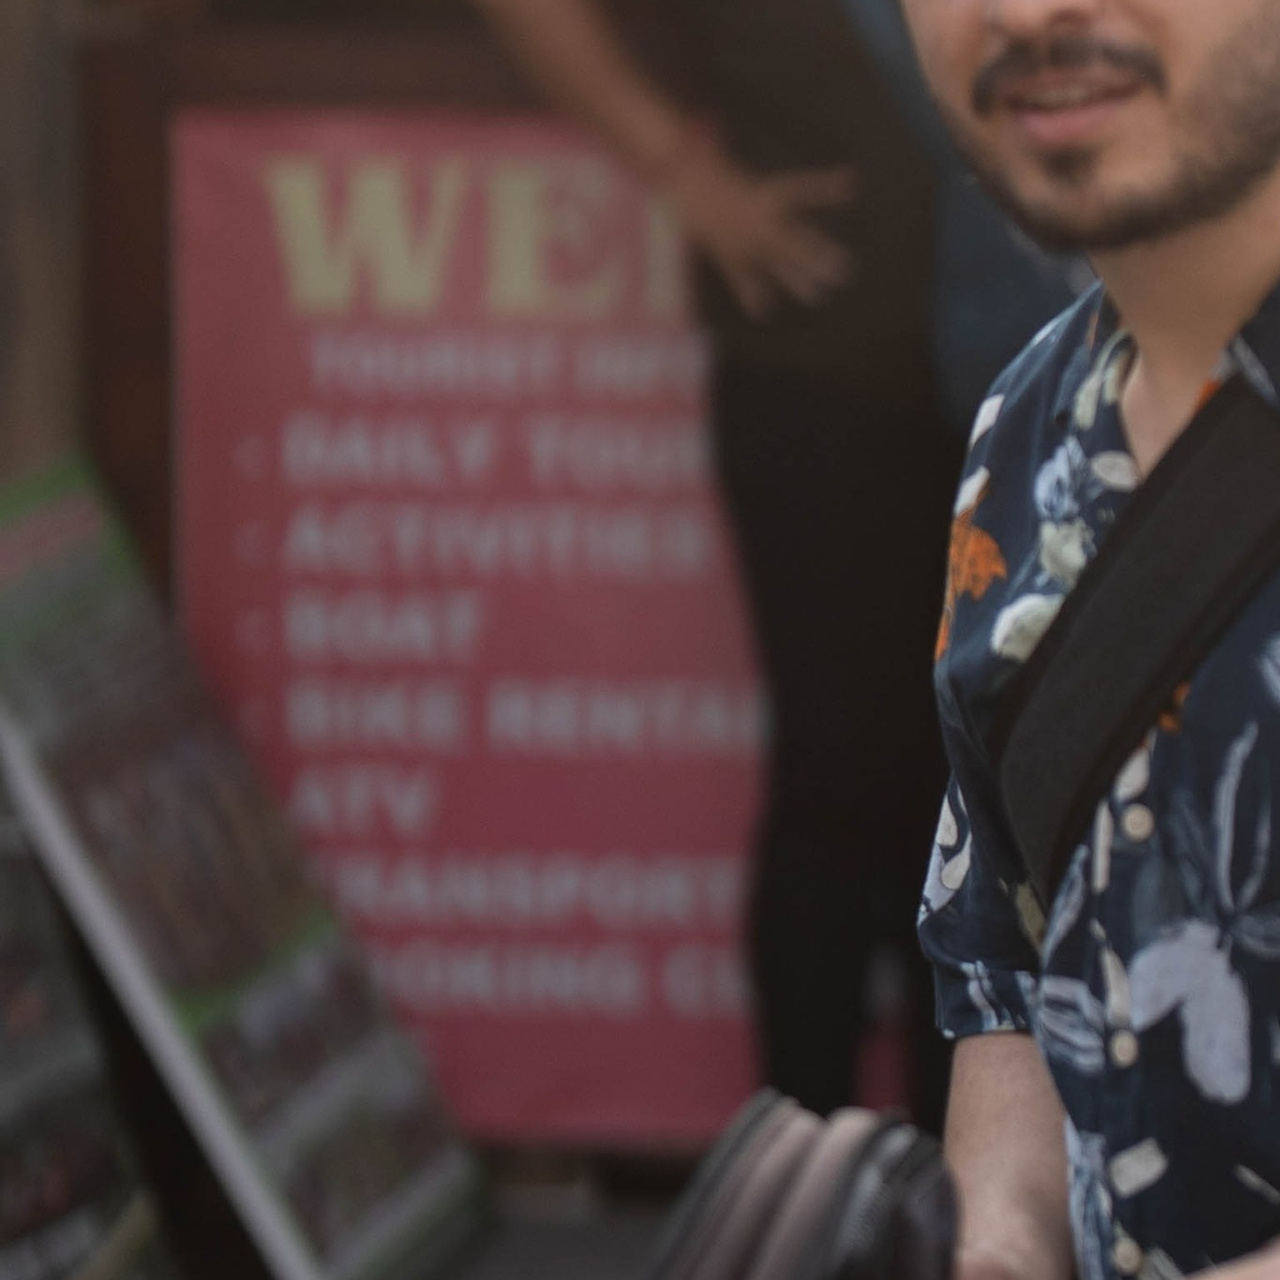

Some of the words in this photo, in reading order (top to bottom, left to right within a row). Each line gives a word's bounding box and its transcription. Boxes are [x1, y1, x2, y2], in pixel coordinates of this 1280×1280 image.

[282, 414, 494, 486] DAILY
[285, 588, 482, 664] BOAT
[287, 677, 462, 754] BIKE
[290, 767, 440, 836] ATV
[325, 853, 746, 928] RANSPORT
